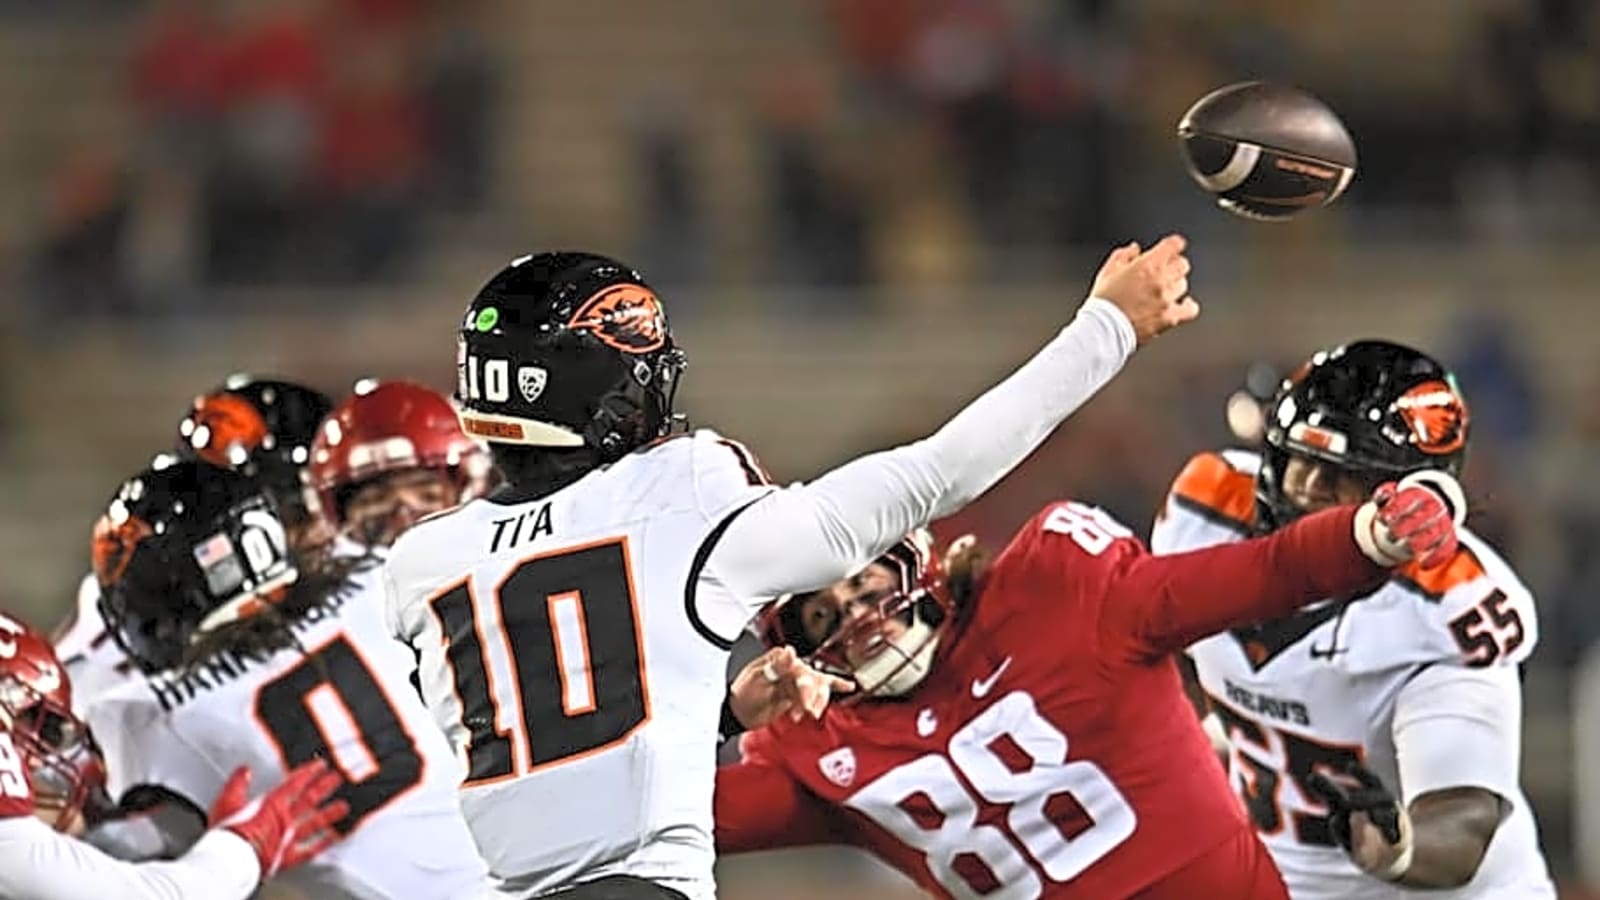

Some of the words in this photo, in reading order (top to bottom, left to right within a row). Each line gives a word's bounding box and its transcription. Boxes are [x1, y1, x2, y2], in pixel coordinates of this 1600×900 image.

[468, 355, 509, 402] 10
[490, 502, 554, 553] TI'A
[429, 535, 652, 788] 10
[1447, 587, 1525, 668] 55
[252, 630, 428, 838] 0
[843, 690, 1138, 900] 88
